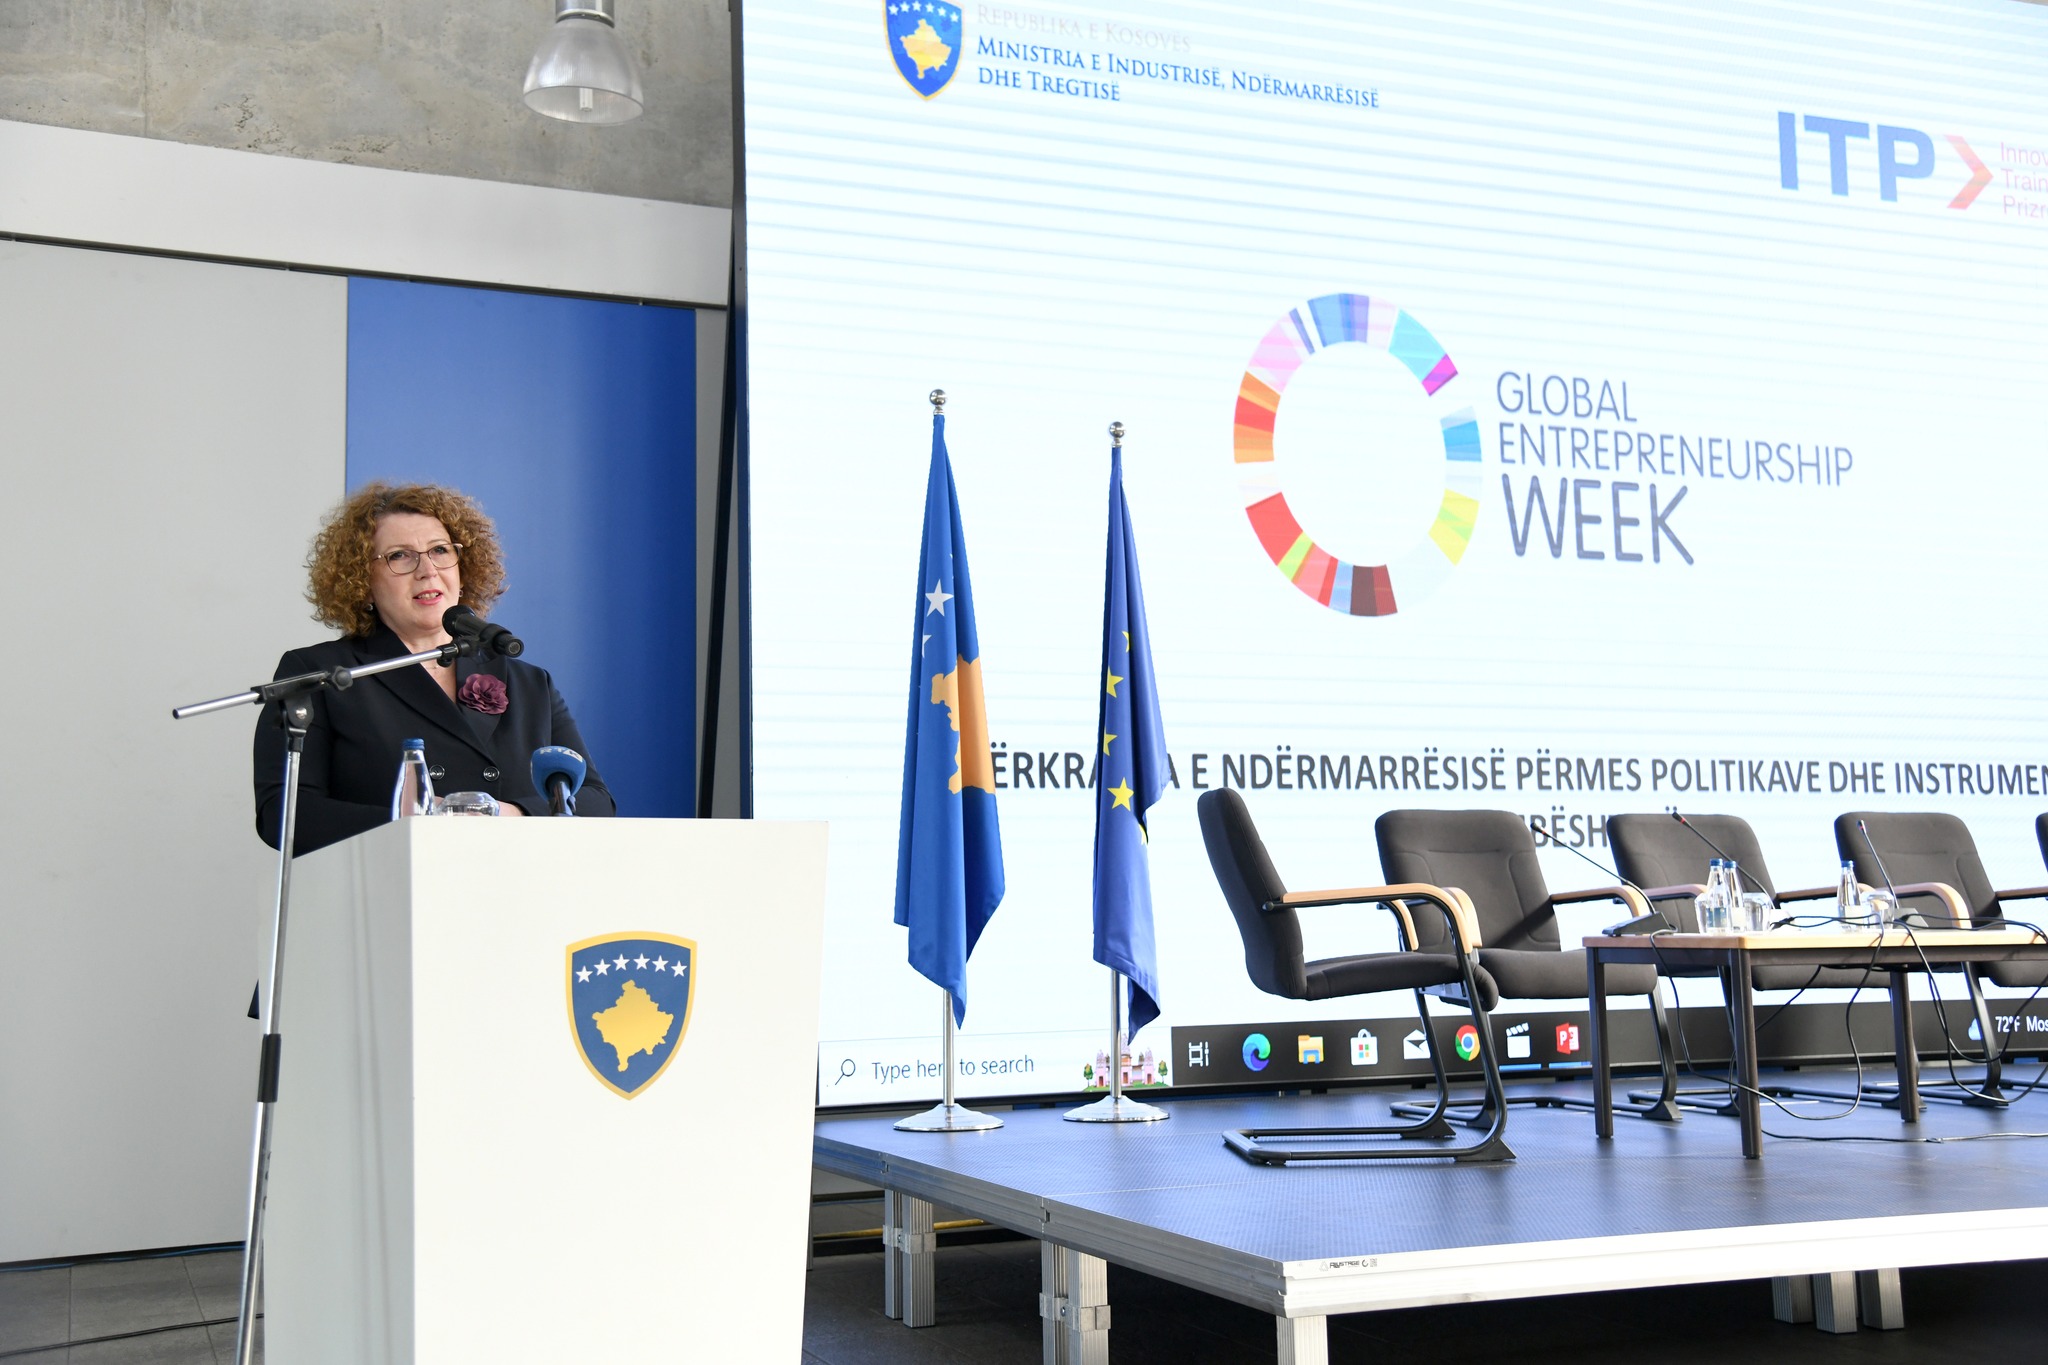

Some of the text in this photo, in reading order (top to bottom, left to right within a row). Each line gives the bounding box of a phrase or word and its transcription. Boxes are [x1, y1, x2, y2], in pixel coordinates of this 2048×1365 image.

[977, 35, 1085, 69] MINISTRIA
[1092, 53, 1101, 71] E
[978, 67, 1121, 101] DHE TREGTISË
[1777, 110, 1936, 203] ITP
[2003, 194, 2048, 219] Prizr
[1496, 371, 1638, 423] GLOBAL
[1499, 422, 1854, 487] ENTREPRENEURSHIP
[1501, 472, 1695, 566] WEEK
[1192, 753, 1209, 789] E
[1223, 744, 1506, 791] NDËRMARRËSISË
[1516, 748, 1642, 792] PËRMES
[1652, 757, 1822, 793] POLITIKAVE
[1829, 761, 1885, 795] DHE
[871, 1054, 1034, 1085] Type her to search
